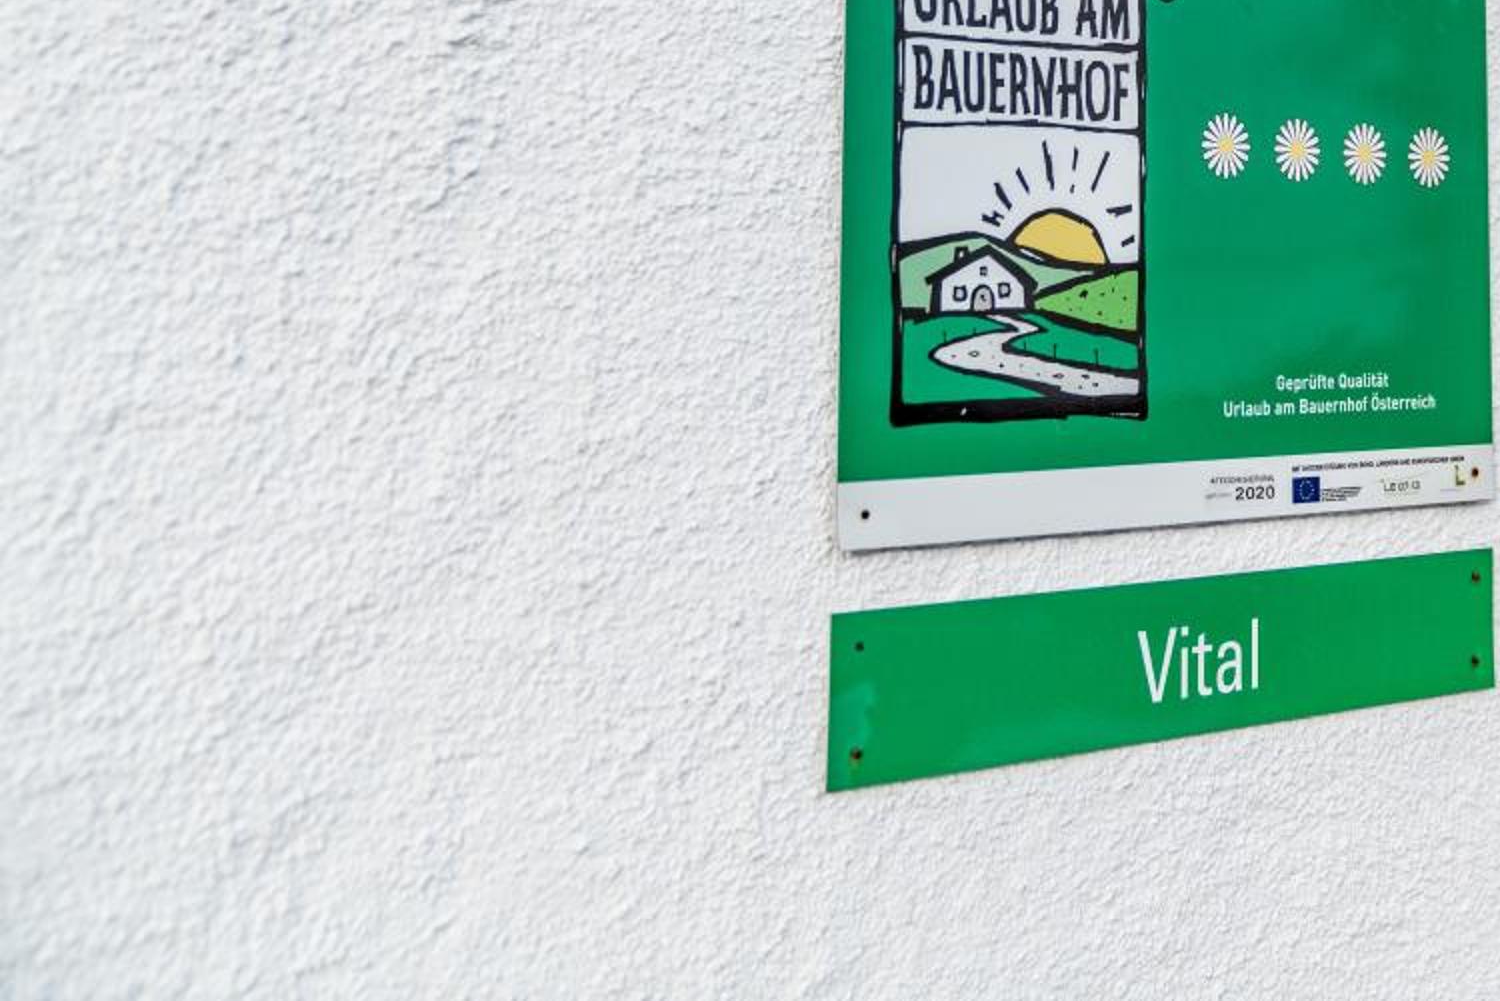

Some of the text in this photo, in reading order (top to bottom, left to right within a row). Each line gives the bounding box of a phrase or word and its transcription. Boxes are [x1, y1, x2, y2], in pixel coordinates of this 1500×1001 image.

[912, 44, 1131, 122] BAUERNHOF
[1276, 372, 1389, 392] Geprüfte Qualität
[1223, 393, 1436, 418] Urlaub am Bauernhof Österreich
[1234, 485, 1275, 501] 2020
[1137, 617, 1260, 704] Vital
